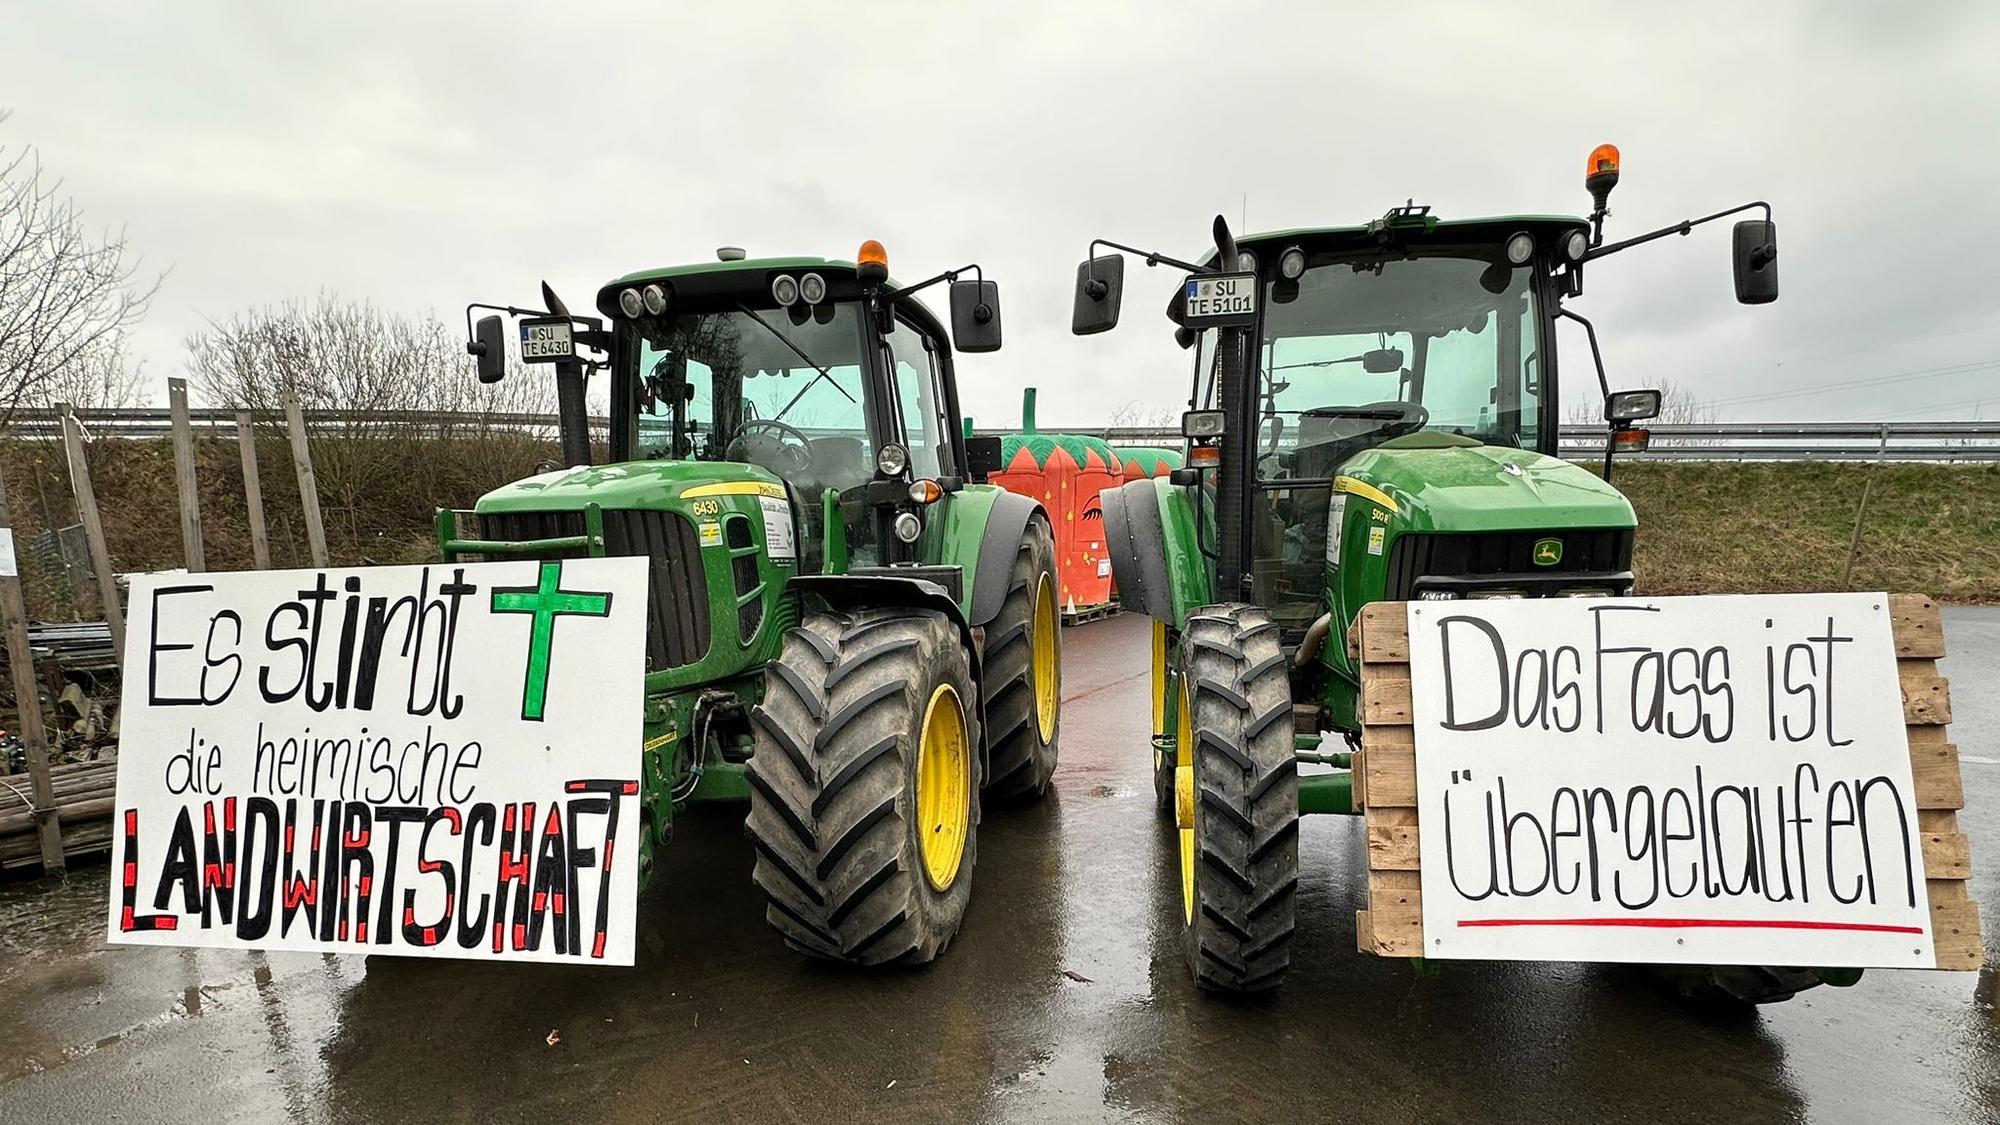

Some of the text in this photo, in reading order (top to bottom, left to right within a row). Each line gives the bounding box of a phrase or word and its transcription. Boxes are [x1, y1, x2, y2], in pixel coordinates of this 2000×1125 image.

[1215, 280, 1236, 296] SU
[1189, 296, 1252, 315] TE 5101
[538, 327, 554, 341] SU
[524, 341, 569, 355] TE 6430
[692, 500, 719, 516] 6430
[148, 566, 477, 720] Es stirbt
[1436, 605, 1855, 747] Das Fass ist
[165, 722, 483, 806] die heimische
[119, 778, 640, 960] LANDWIRTSCHAFT
